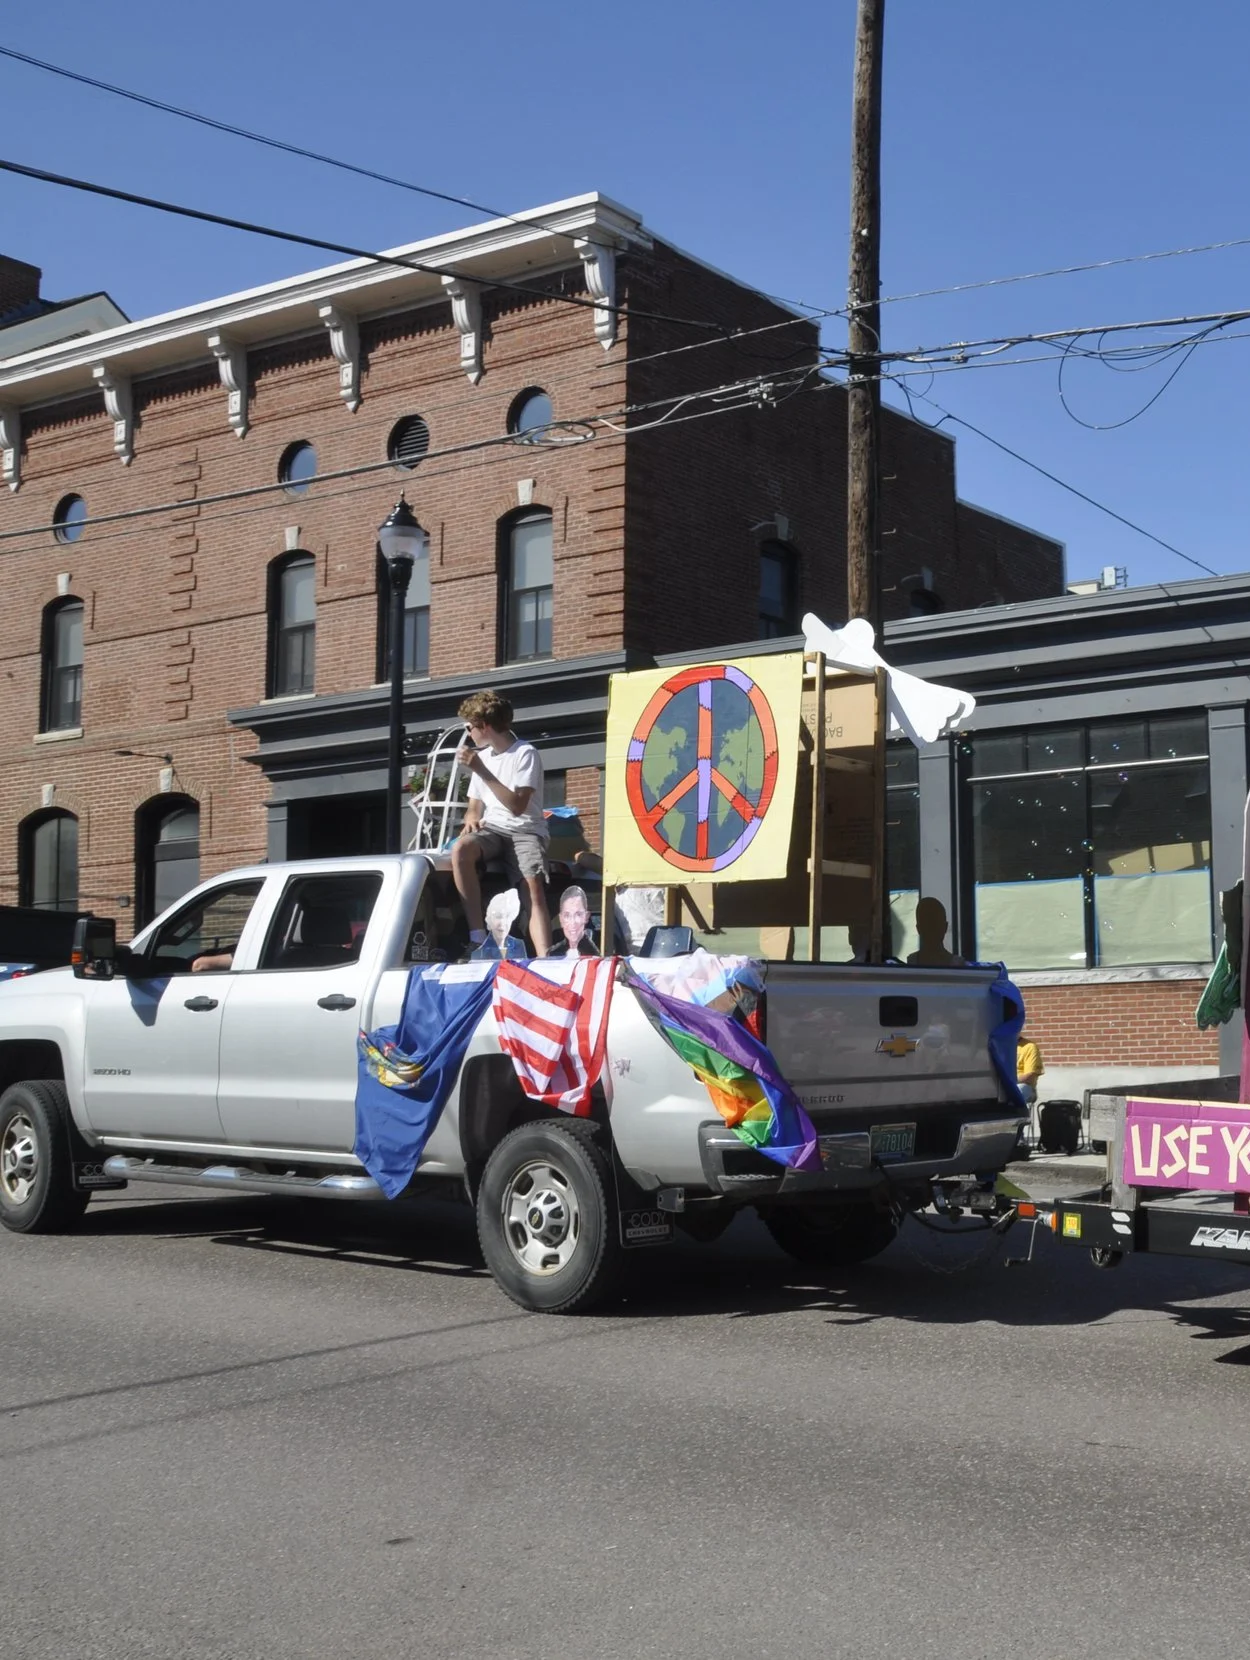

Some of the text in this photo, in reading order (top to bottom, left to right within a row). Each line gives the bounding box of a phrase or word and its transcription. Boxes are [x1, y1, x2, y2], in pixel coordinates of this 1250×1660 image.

[1130, 1123, 1213, 1178] USE
[83, 1164, 104, 1176] CO
[630, 1211, 666, 1228] CODY
